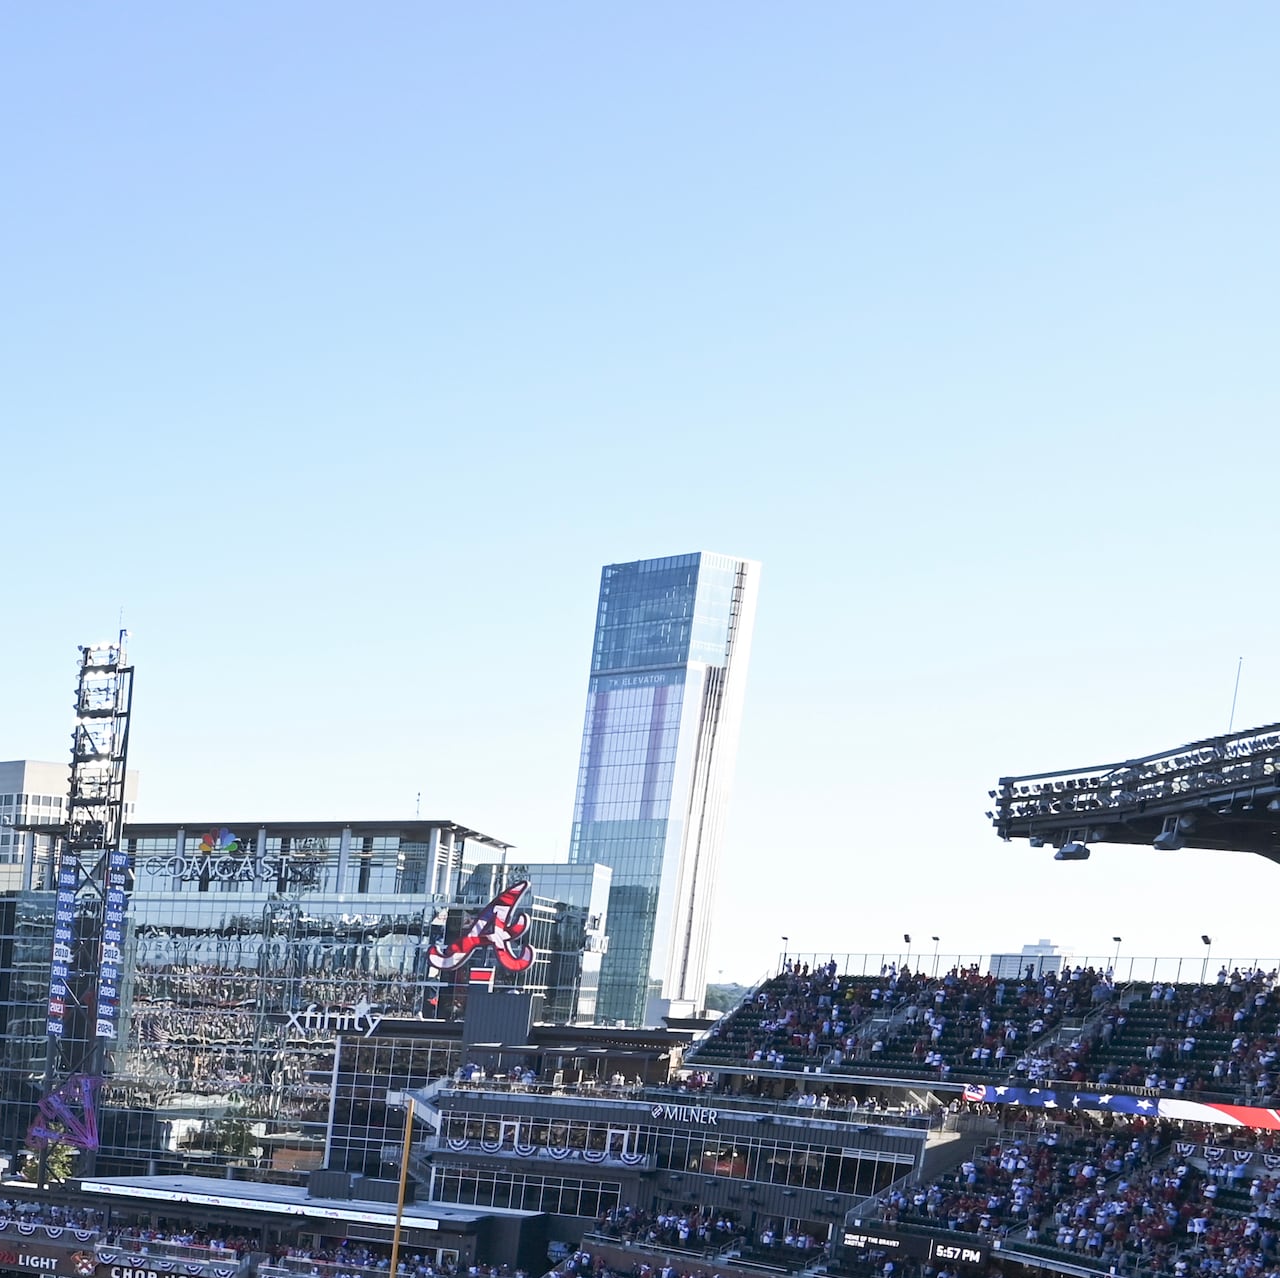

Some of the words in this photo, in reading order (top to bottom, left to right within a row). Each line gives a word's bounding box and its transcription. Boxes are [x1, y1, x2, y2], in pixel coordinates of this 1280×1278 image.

[112, 854, 127, 865] 1997
[143, 855, 291, 879] COMCAST
[60, 874, 75, 885] 1998
[110, 873, 126, 884] 1999
[57, 911, 72, 922] 2002
[107, 911, 122, 922] 2003
[56, 929, 71, 940] 2004
[106, 930, 121, 941] 2005
[54, 948, 69, 958] 2010
[104, 950, 118, 960] 2012
[52, 966, 68, 976] 2013
[51, 984, 66, 996] 2019
[100, 986, 116, 998] 2020
[50, 1002, 64, 1014] 2021
[98, 1004, 114, 1016] 2022
[285, 1002, 383, 1038] xfinity
[48, 1022, 62, 1033] 2023
[98, 1024, 112, 1034] 2024
[664, 1104, 718, 1126] MILNER
[936, 1244, 962, 1259] 5:57
[961, 1248, 981, 1263] PM
[18, 1254, 58, 1270] LIGHT
